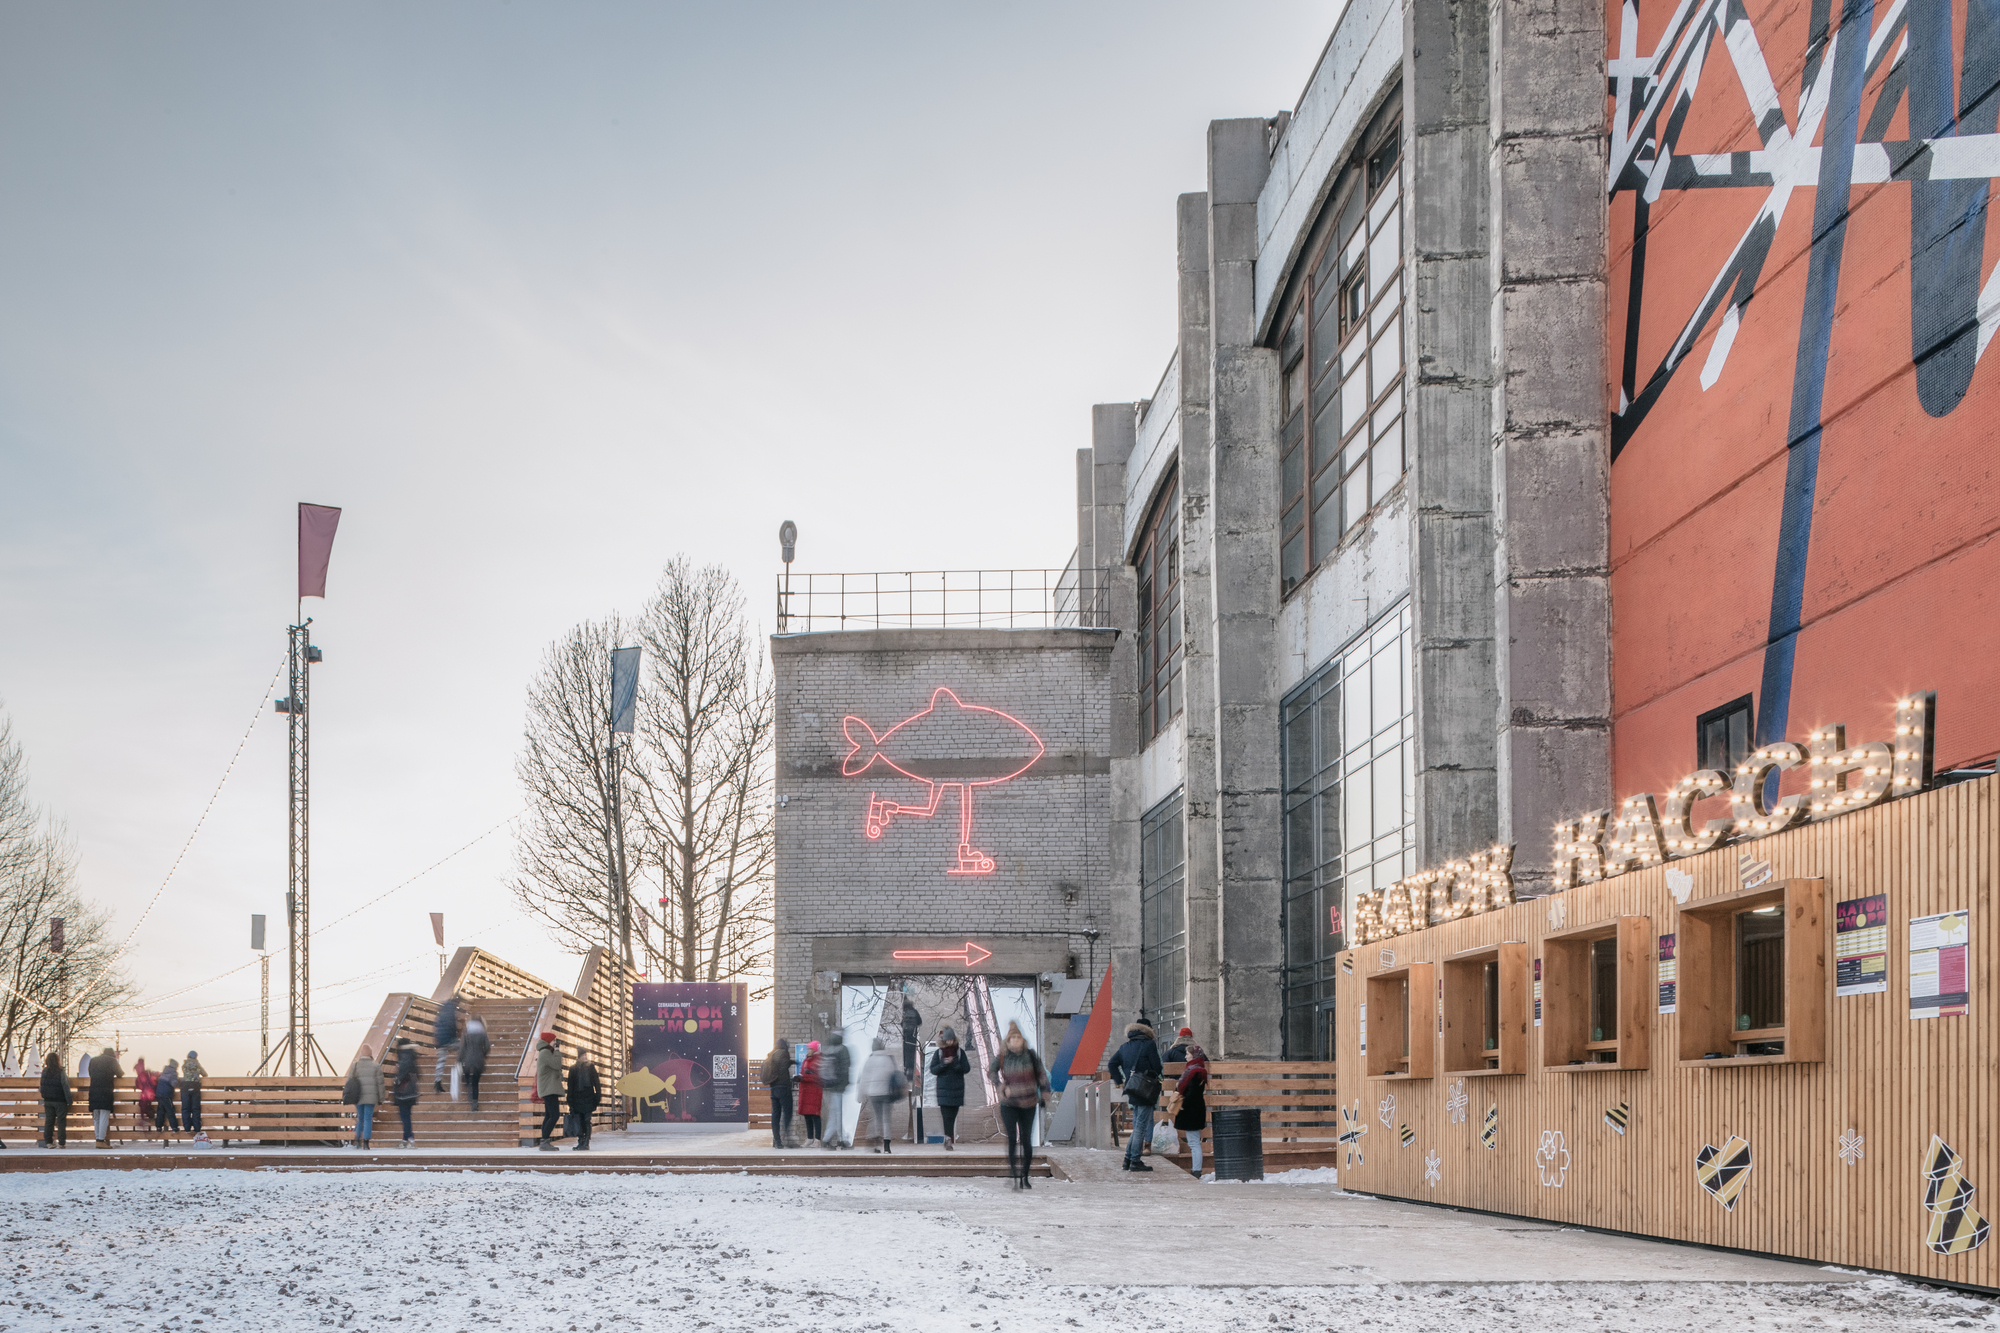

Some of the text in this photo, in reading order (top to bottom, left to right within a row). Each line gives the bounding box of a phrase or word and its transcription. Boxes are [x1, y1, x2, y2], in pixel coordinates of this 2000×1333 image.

[1355, 690, 1937, 945] КАТОК КАССЫ
[1837, 898, 1885, 917] КАТОК
[1844, 910, 1886, 929] МОРЯ
[658, 1006, 723, 1019] КАТОК
[667, 1019, 723, 1033] МОРЯ
